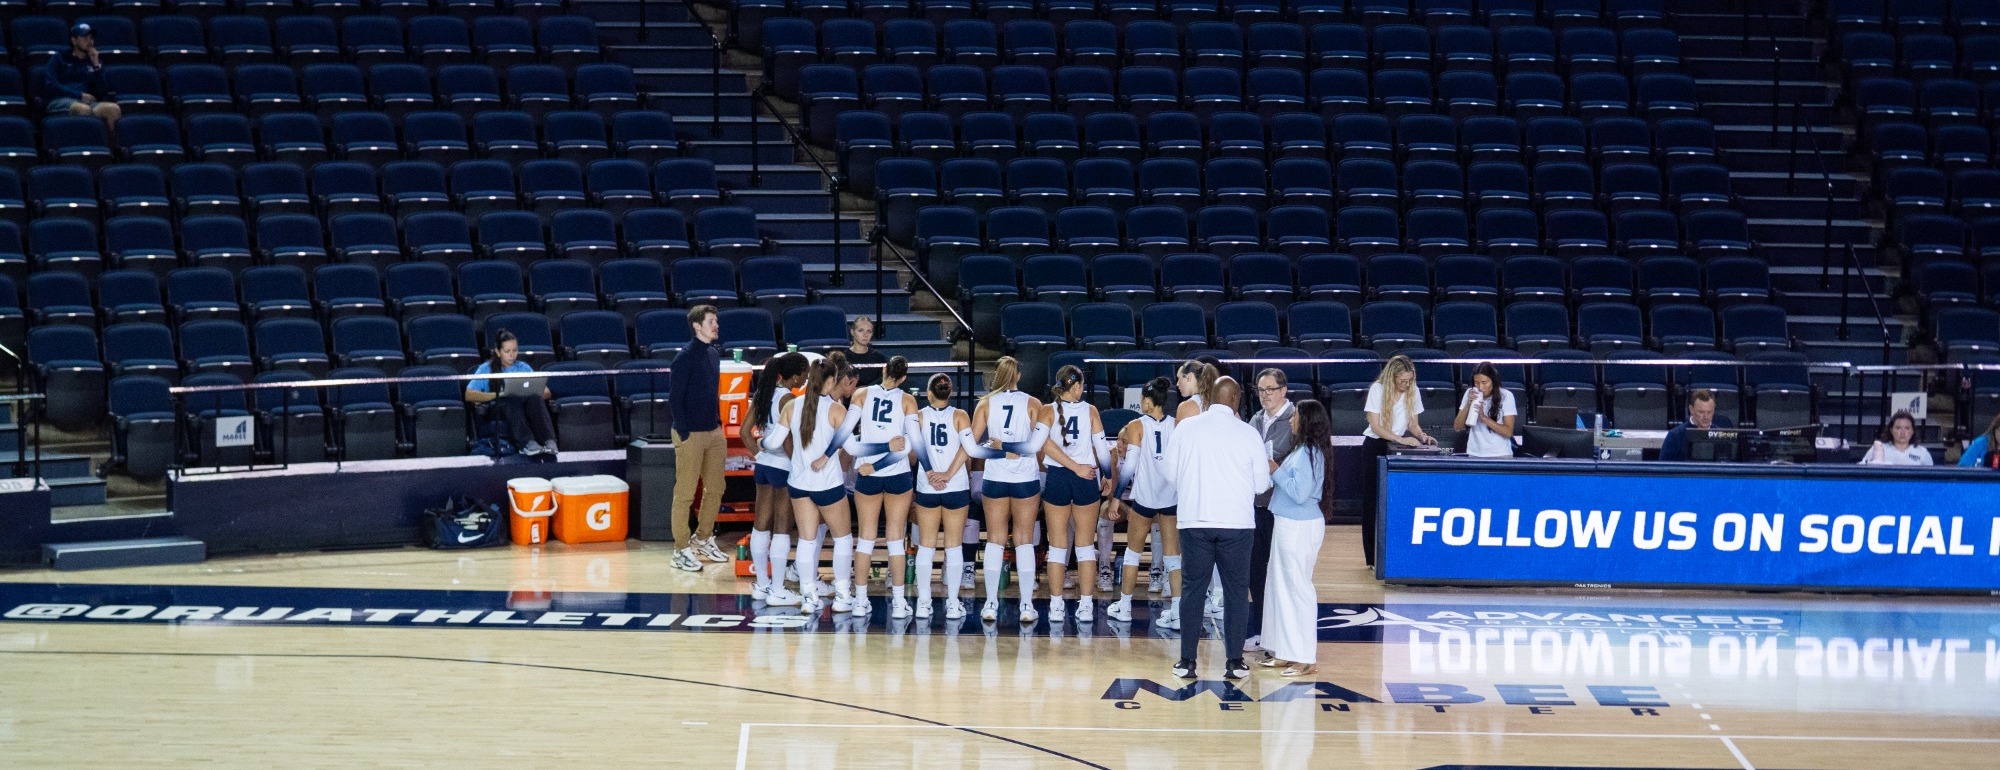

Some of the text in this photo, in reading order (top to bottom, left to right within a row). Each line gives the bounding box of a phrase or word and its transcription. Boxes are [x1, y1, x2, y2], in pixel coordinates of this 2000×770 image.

[872, 397, 893, 423] 12
[1002, 405, 1014, 429] 7
[929, 422, 949, 447] 16
[1155, 431, 1162, 454] 1
[586, 502, 611, 531] G
[1411, 507, 1621, 548] FOLLOW
[1633, 511, 1697, 551] US
[1712, 513, 1784, 552] ON
[1799, 514, 1974, 556] SOCIAL
[3, 603, 811, 628] @ORUATHLETICS
[1427, 610, 1784, 626] ADVANCED
[1448, 619, 1784, 631] ORTHOPEDICS
[1100, 678, 1671, 708] MABEE
[1114, 701, 1660, 717] CENTER
